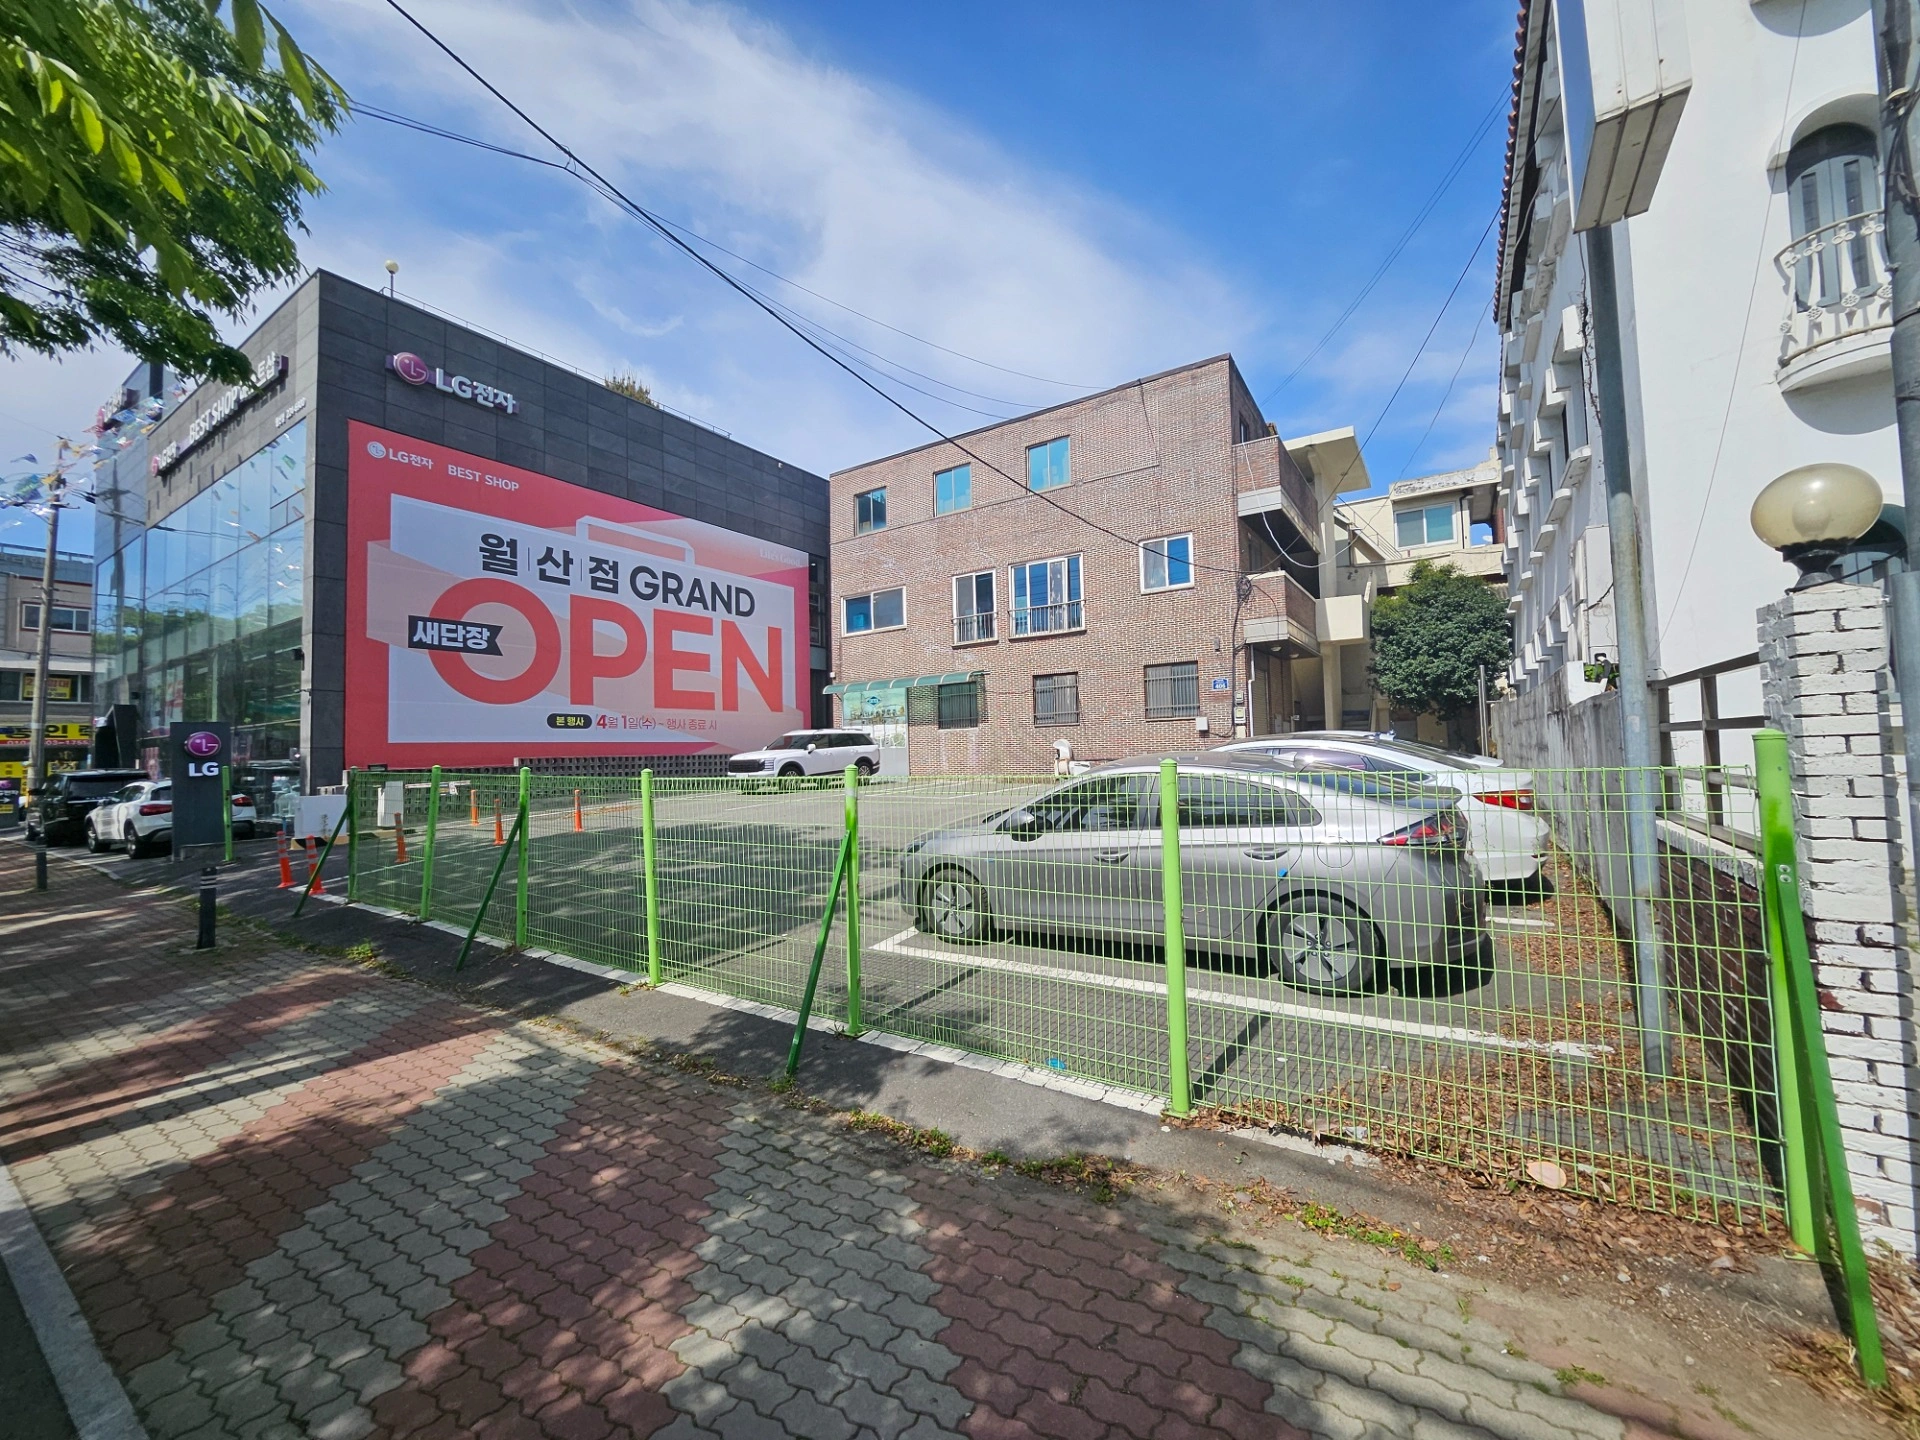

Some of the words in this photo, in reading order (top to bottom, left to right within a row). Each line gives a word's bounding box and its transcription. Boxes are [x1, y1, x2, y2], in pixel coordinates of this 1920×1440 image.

[435, 367, 516, 414] LG전자
[188, 408, 211, 444] BEST
[211, 385, 239, 425] SHOP
[388, 448, 434, 470] LG전자
[447, 464, 481, 482] BEST
[484, 474, 520, 492] SHOP
[629, 565, 756, 618] GRAND
[413, 620, 490, 650] 새단장
[428, 577, 784, 713] OPEN
[556, 716, 565, 726] 본
[567, 716, 584, 727] 행사
[596, 714, 618, 730] 4월
[621, 715, 656, 730] 1일(수)
[667, 718, 686, 730] 행사
[688, 719, 706, 731] 종료
[709, 720, 717, 731] 시
[188, 761, 219, 777] LG
